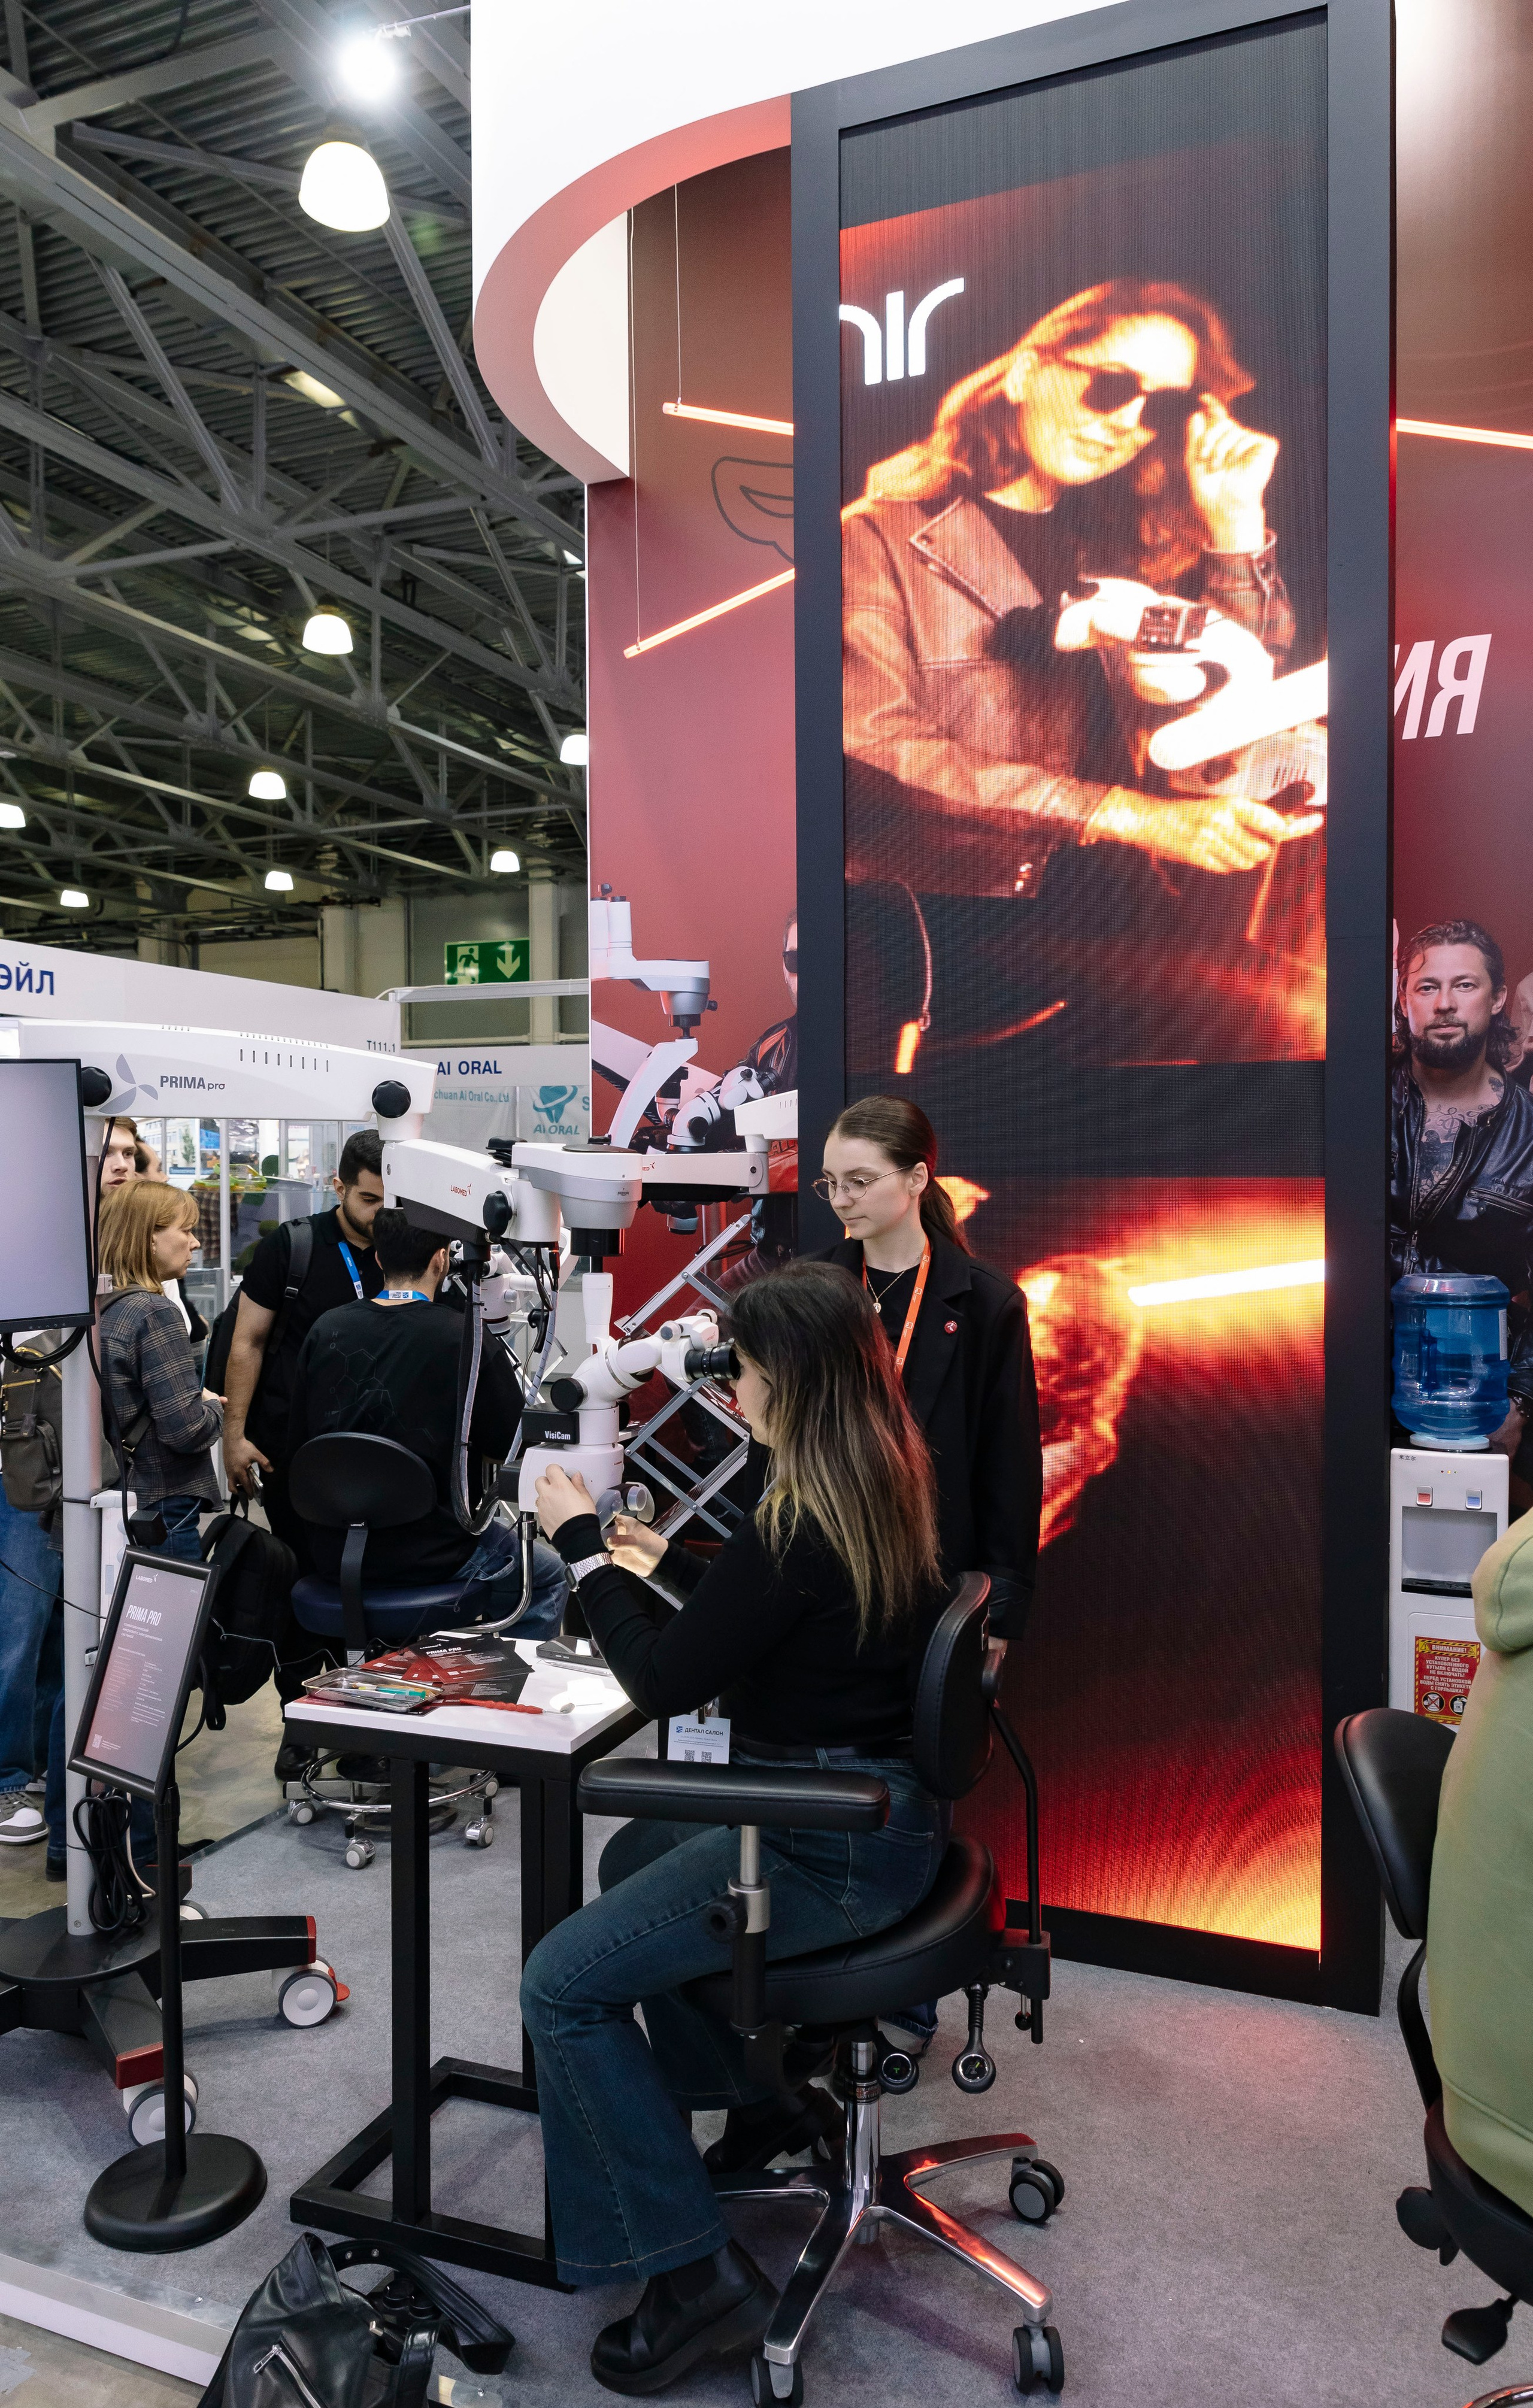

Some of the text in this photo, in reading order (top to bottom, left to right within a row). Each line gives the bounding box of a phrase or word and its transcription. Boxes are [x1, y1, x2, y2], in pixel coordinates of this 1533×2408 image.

[0, 961, 54, 996] ЭЙЛ
[366, 1041, 395, 1053] T111.1
[459, 1060, 502, 1075] ORAL
[459, 1090, 467, 1100] Ai
[468, 1090, 483, 1102] Oral
[548, 1124, 580, 1135] ORAL
[450, 1185, 468, 1197] LABOMED
[545, 1430, 571, 1440] VisiCam
[126, 1605, 162, 1626] PRIMA PRO
[1432, 1645, 1467, 1653] ВНИМАНИЕ!
[1426, 1660, 1469, 1668] УСТАНОВЛЕННОГО
